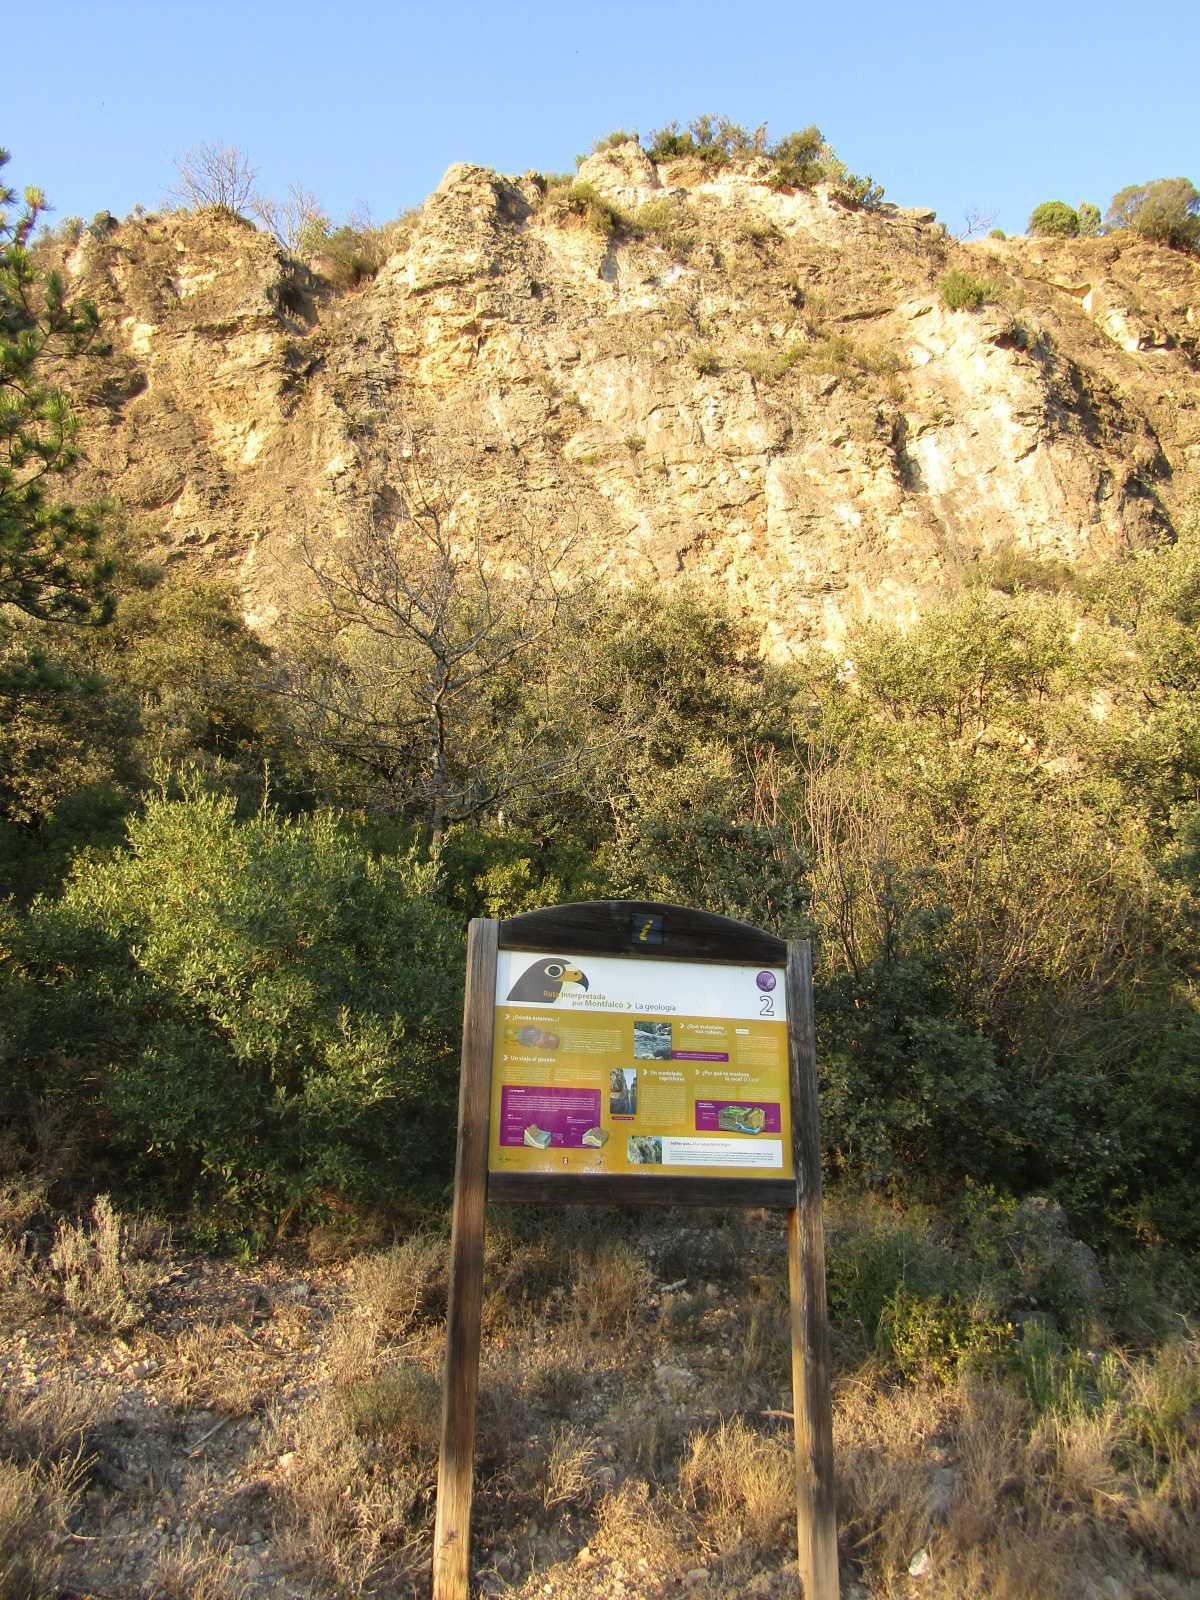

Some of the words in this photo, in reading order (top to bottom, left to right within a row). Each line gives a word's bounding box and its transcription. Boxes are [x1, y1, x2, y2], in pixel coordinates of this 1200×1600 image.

[544, 990, 560, 998] Ruta
[561, 991, 606, 1001] Interpretada
[759, 995, 775, 1016] 2
